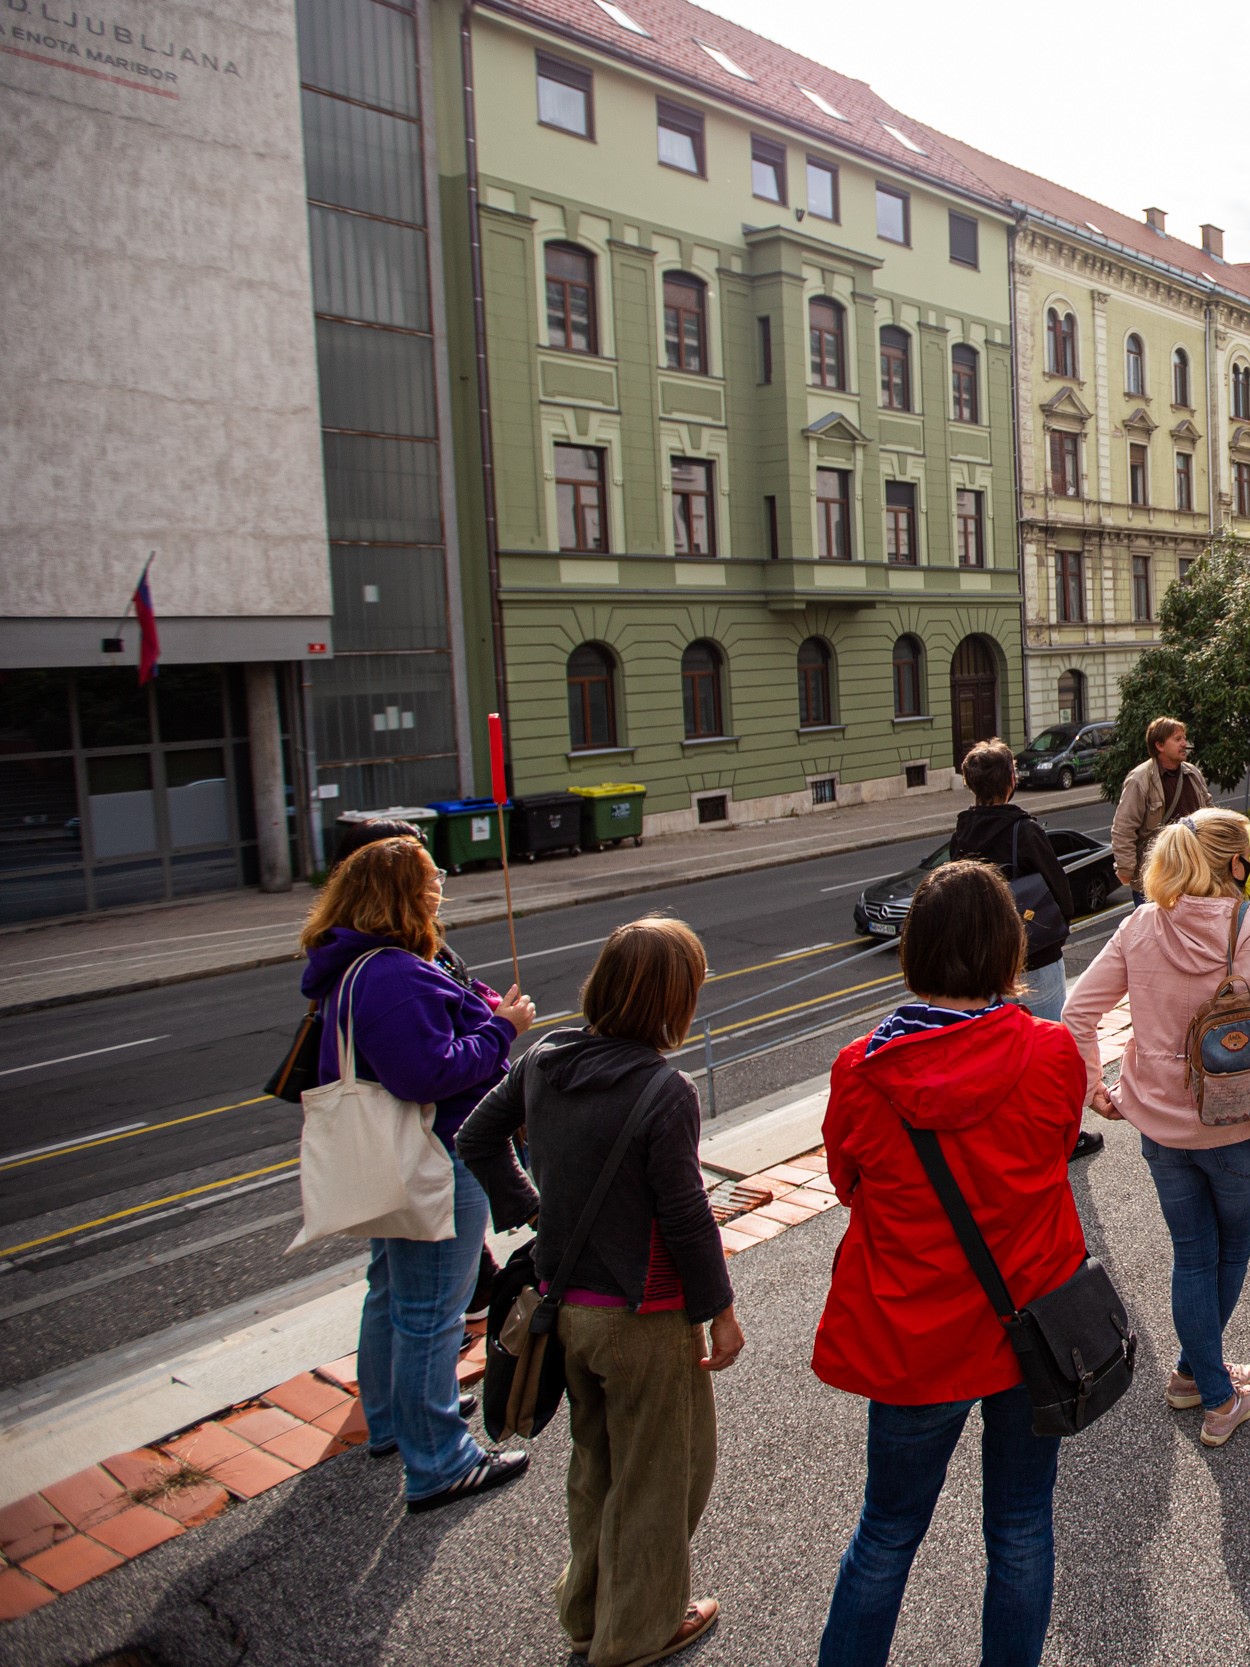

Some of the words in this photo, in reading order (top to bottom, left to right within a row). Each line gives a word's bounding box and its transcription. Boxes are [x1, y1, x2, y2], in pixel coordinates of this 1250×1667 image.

[12, 26, 81, 57] ENOTA
[85, 48, 179, 84] MARIBOR
[41, 3, 242, 79] LJUBLJANA
